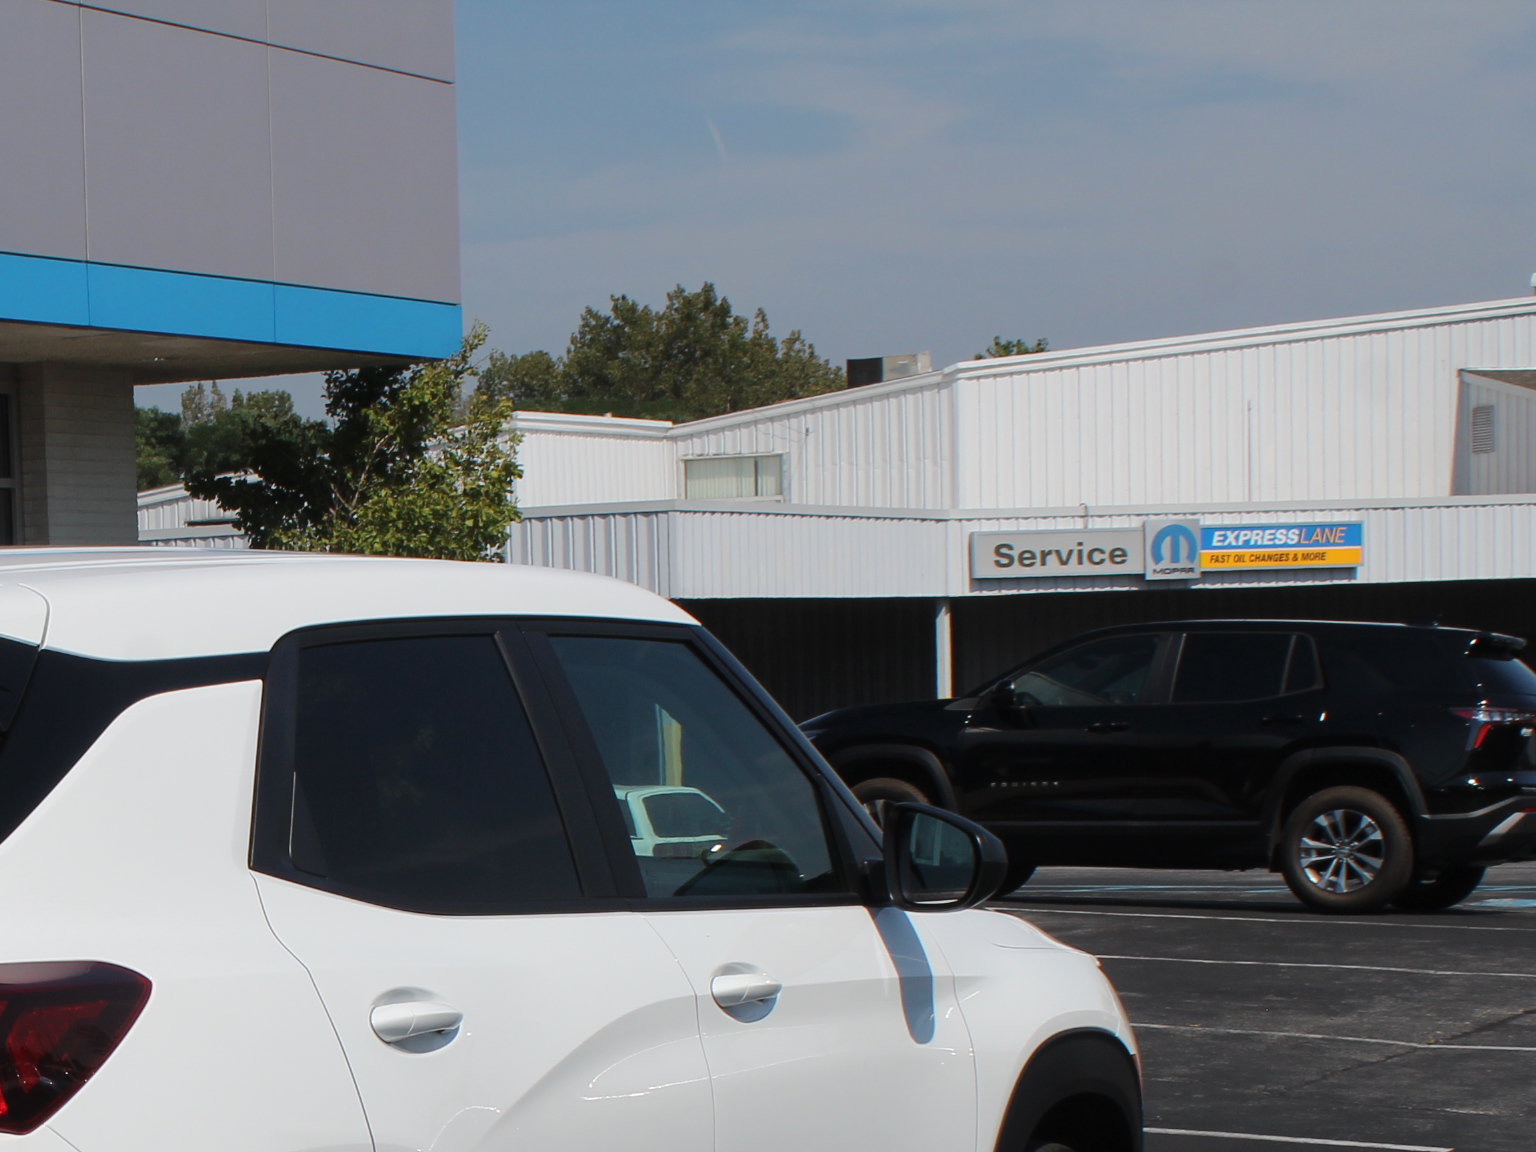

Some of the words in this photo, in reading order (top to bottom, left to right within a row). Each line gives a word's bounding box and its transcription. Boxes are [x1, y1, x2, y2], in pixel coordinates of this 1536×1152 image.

[993, 540, 1128, 568] Service
[1209, 554, 1231, 564] FAST
[1233, 553, 1247, 563] OIL
[1250, 552, 1290, 563] CHANGES
[1292, 552, 1299, 562] &
[1301, 551, 1327, 561] MORE
[1153, 567, 1195, 575] MOPAR
